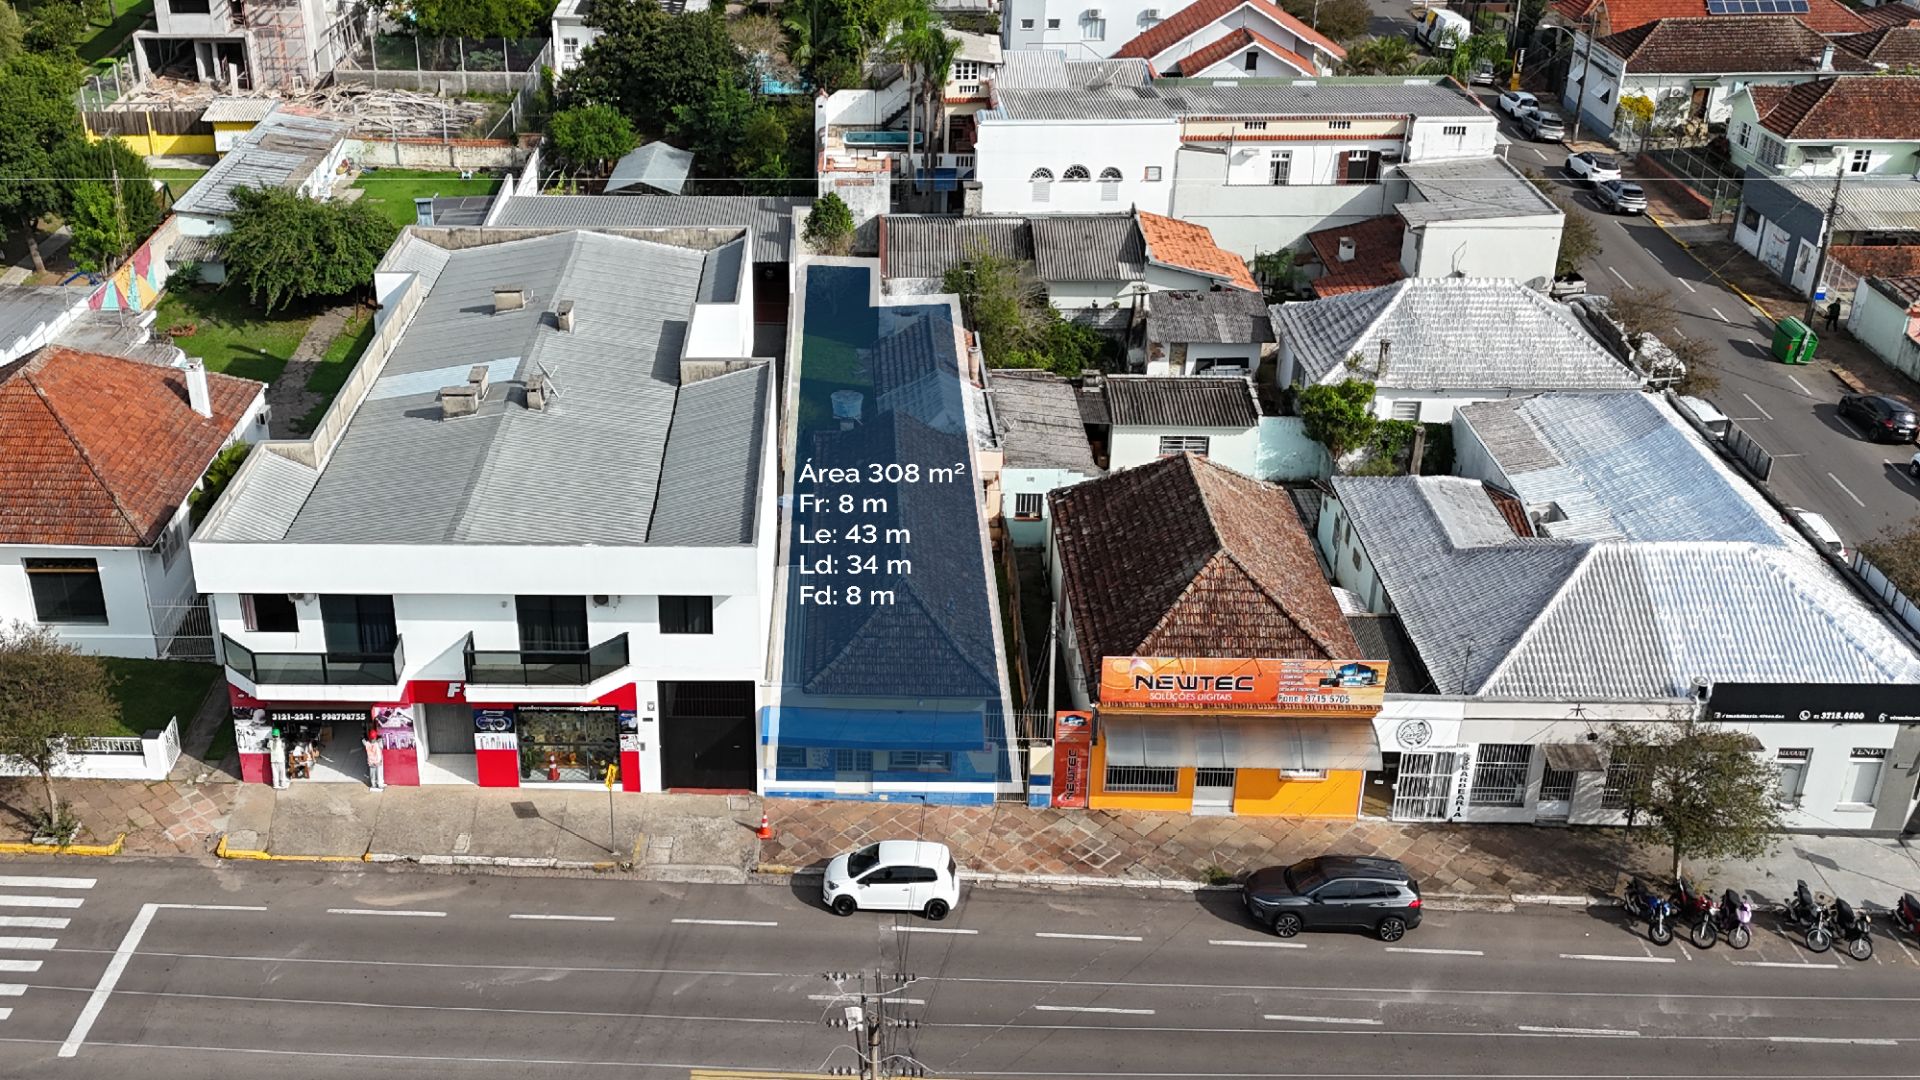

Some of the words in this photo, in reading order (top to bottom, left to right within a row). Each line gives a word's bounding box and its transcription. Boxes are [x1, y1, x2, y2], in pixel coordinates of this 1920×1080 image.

[1134, 674, 1254, 693] NEWTEC
[1149, 691, 1196, 702] SOLUÇÕES
[1197, 692, 1233, 702] DIGITAIS
[1304, 694, 1327, 703] 3715
[1851, 748, 1885, 756] VENDA
[1065, 749, 1077, 800] NEWTEC
